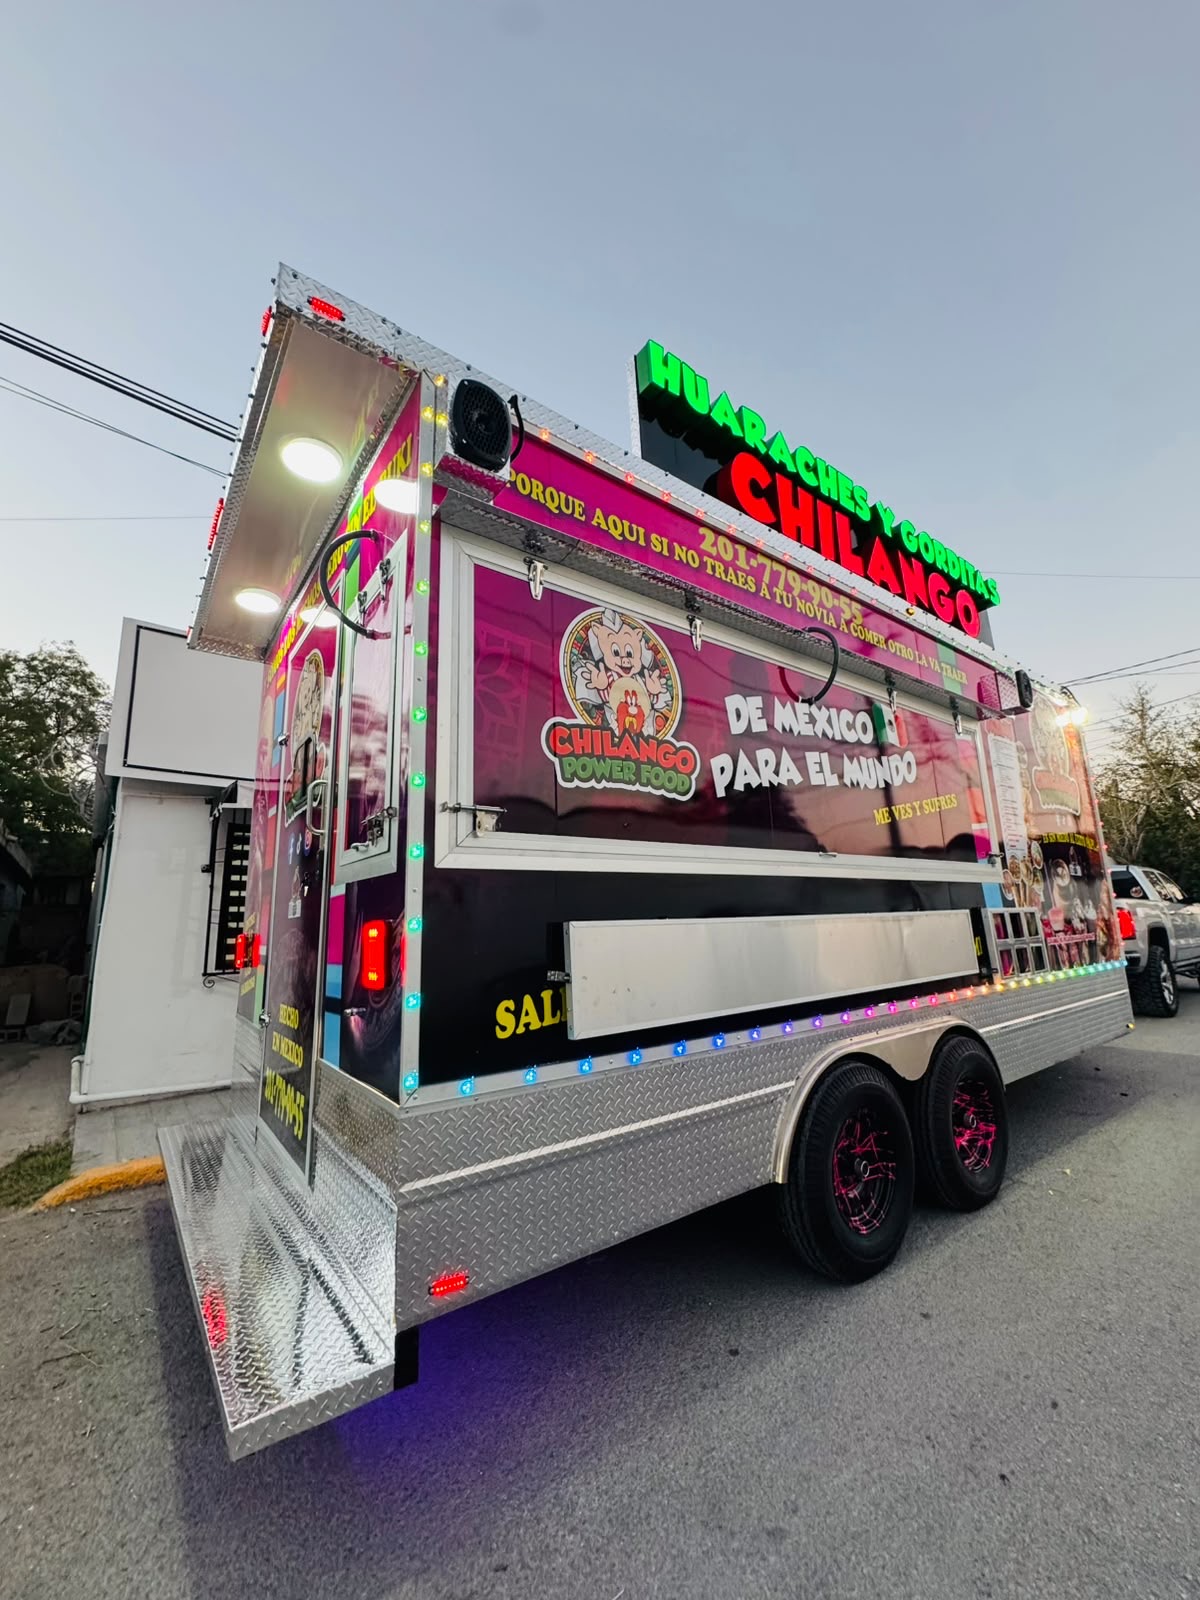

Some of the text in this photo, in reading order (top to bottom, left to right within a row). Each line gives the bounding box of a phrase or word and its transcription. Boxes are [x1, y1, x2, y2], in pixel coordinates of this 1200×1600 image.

[649, 339, 1001, 605] HUARACHES Y GORDITAS
[731, 451, 981, 638] CHILANGO
[591, 507, 646, 547] AQUI
[650, 533, 669, 557] SI
[674, 542, 700, 569] NO
[703, 555, 757, 593] TRAES
[759, 582, 772, 600] A
[773, 586, 793, 609] TU
[796, 596, 837, 629] NOVIA
[839, 619, 849, 633] A
[850, 623, 888, 650] COMER
[888, 639, 914, 662] OTRO
[915, 651, 927, 668] LA
[929, 657, 941, 673] VA
[941, 662, 968, 685] TRAER
[698, 526, 864, 626] 201-779-90-55
[724, 693, 768, 735] DE
[549, 725, 696, 774] CHILANGO
[709, 747, 918, 798] PARA EL MUNDO
[561, 756, 692, 793] POWER FOOD
[873, 793, 958, 826] ME VES Y SUFRES
[279, 1003, 299, 1030] HECHO
[272, 1031, 304, 1069] EN MEXICO
